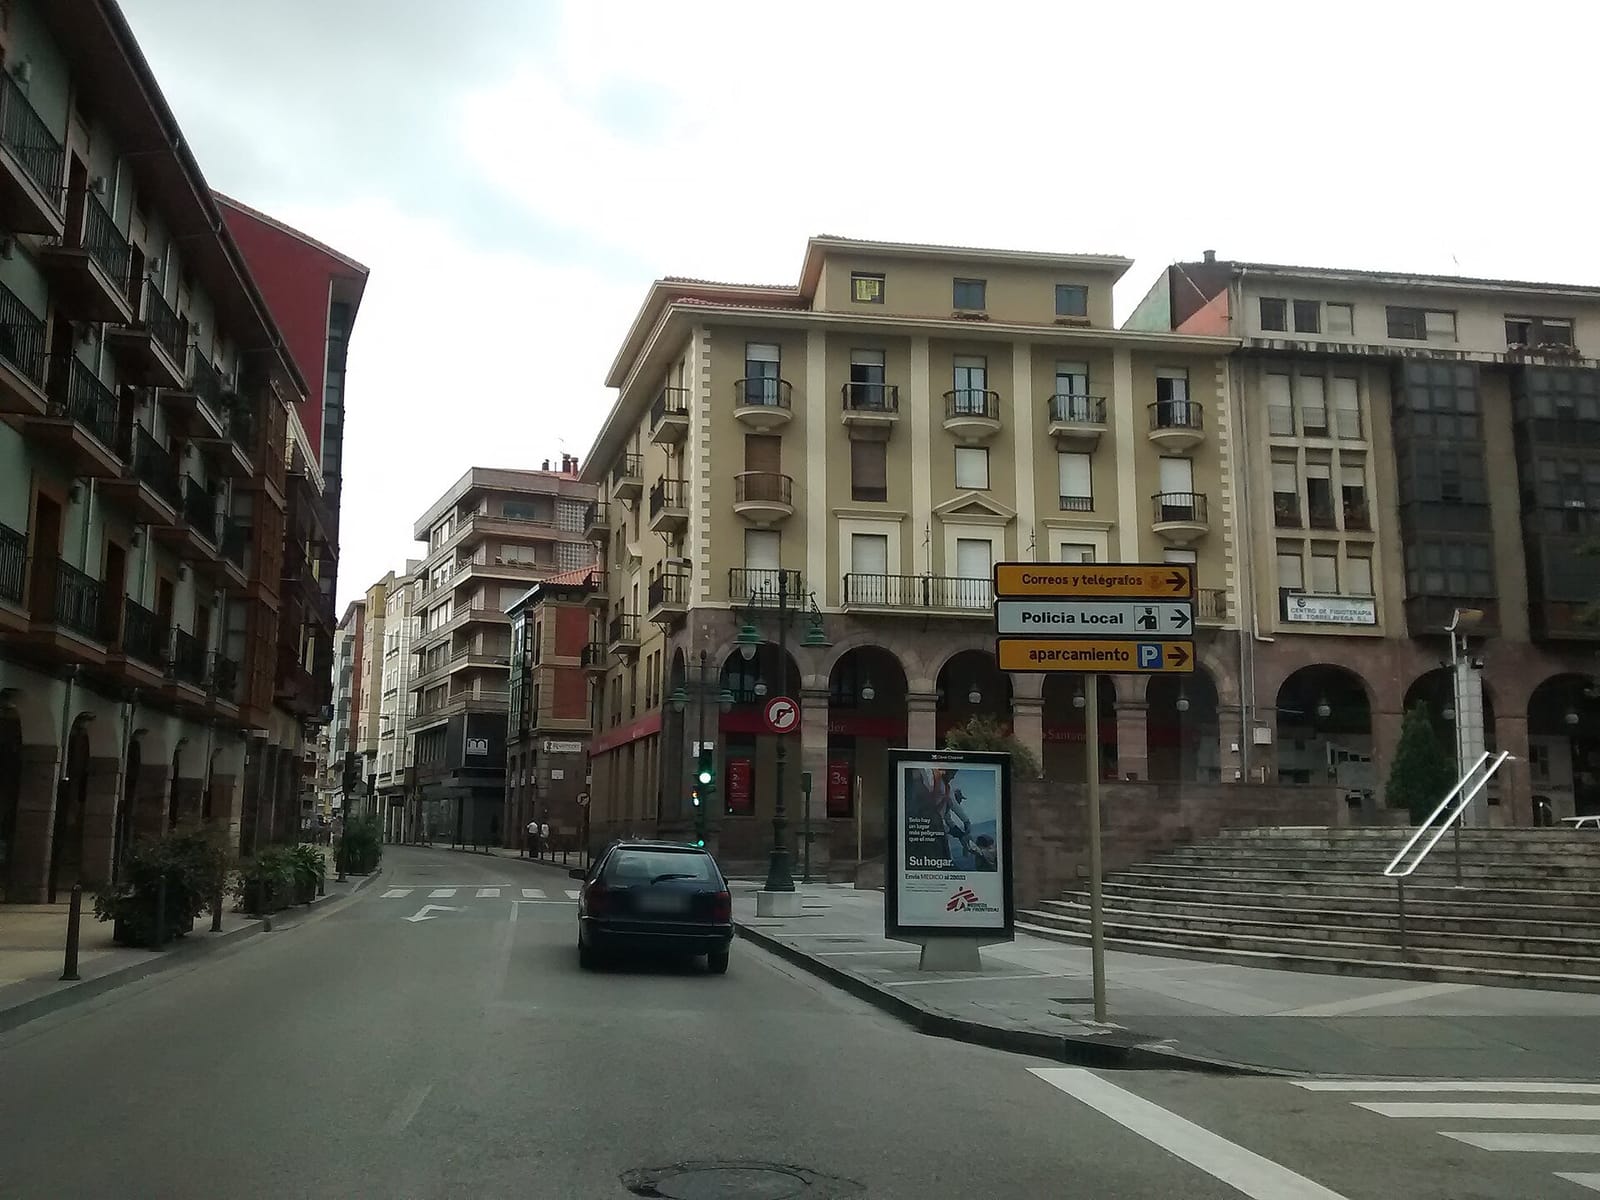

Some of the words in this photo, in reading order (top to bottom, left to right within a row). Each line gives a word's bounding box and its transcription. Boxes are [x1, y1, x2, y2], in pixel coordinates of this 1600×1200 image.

[1022, 574, 1068, 585] Correos
[1072, 577, 1079, 588] y
[1080, 612, 1124, 624] Local
[1029, 649, 1129, 663] aparcamiento
[1141, 646, 1158, 667] P
[909, 856, 923, 866] Su
[923, 856, 954, 869] hogar.
